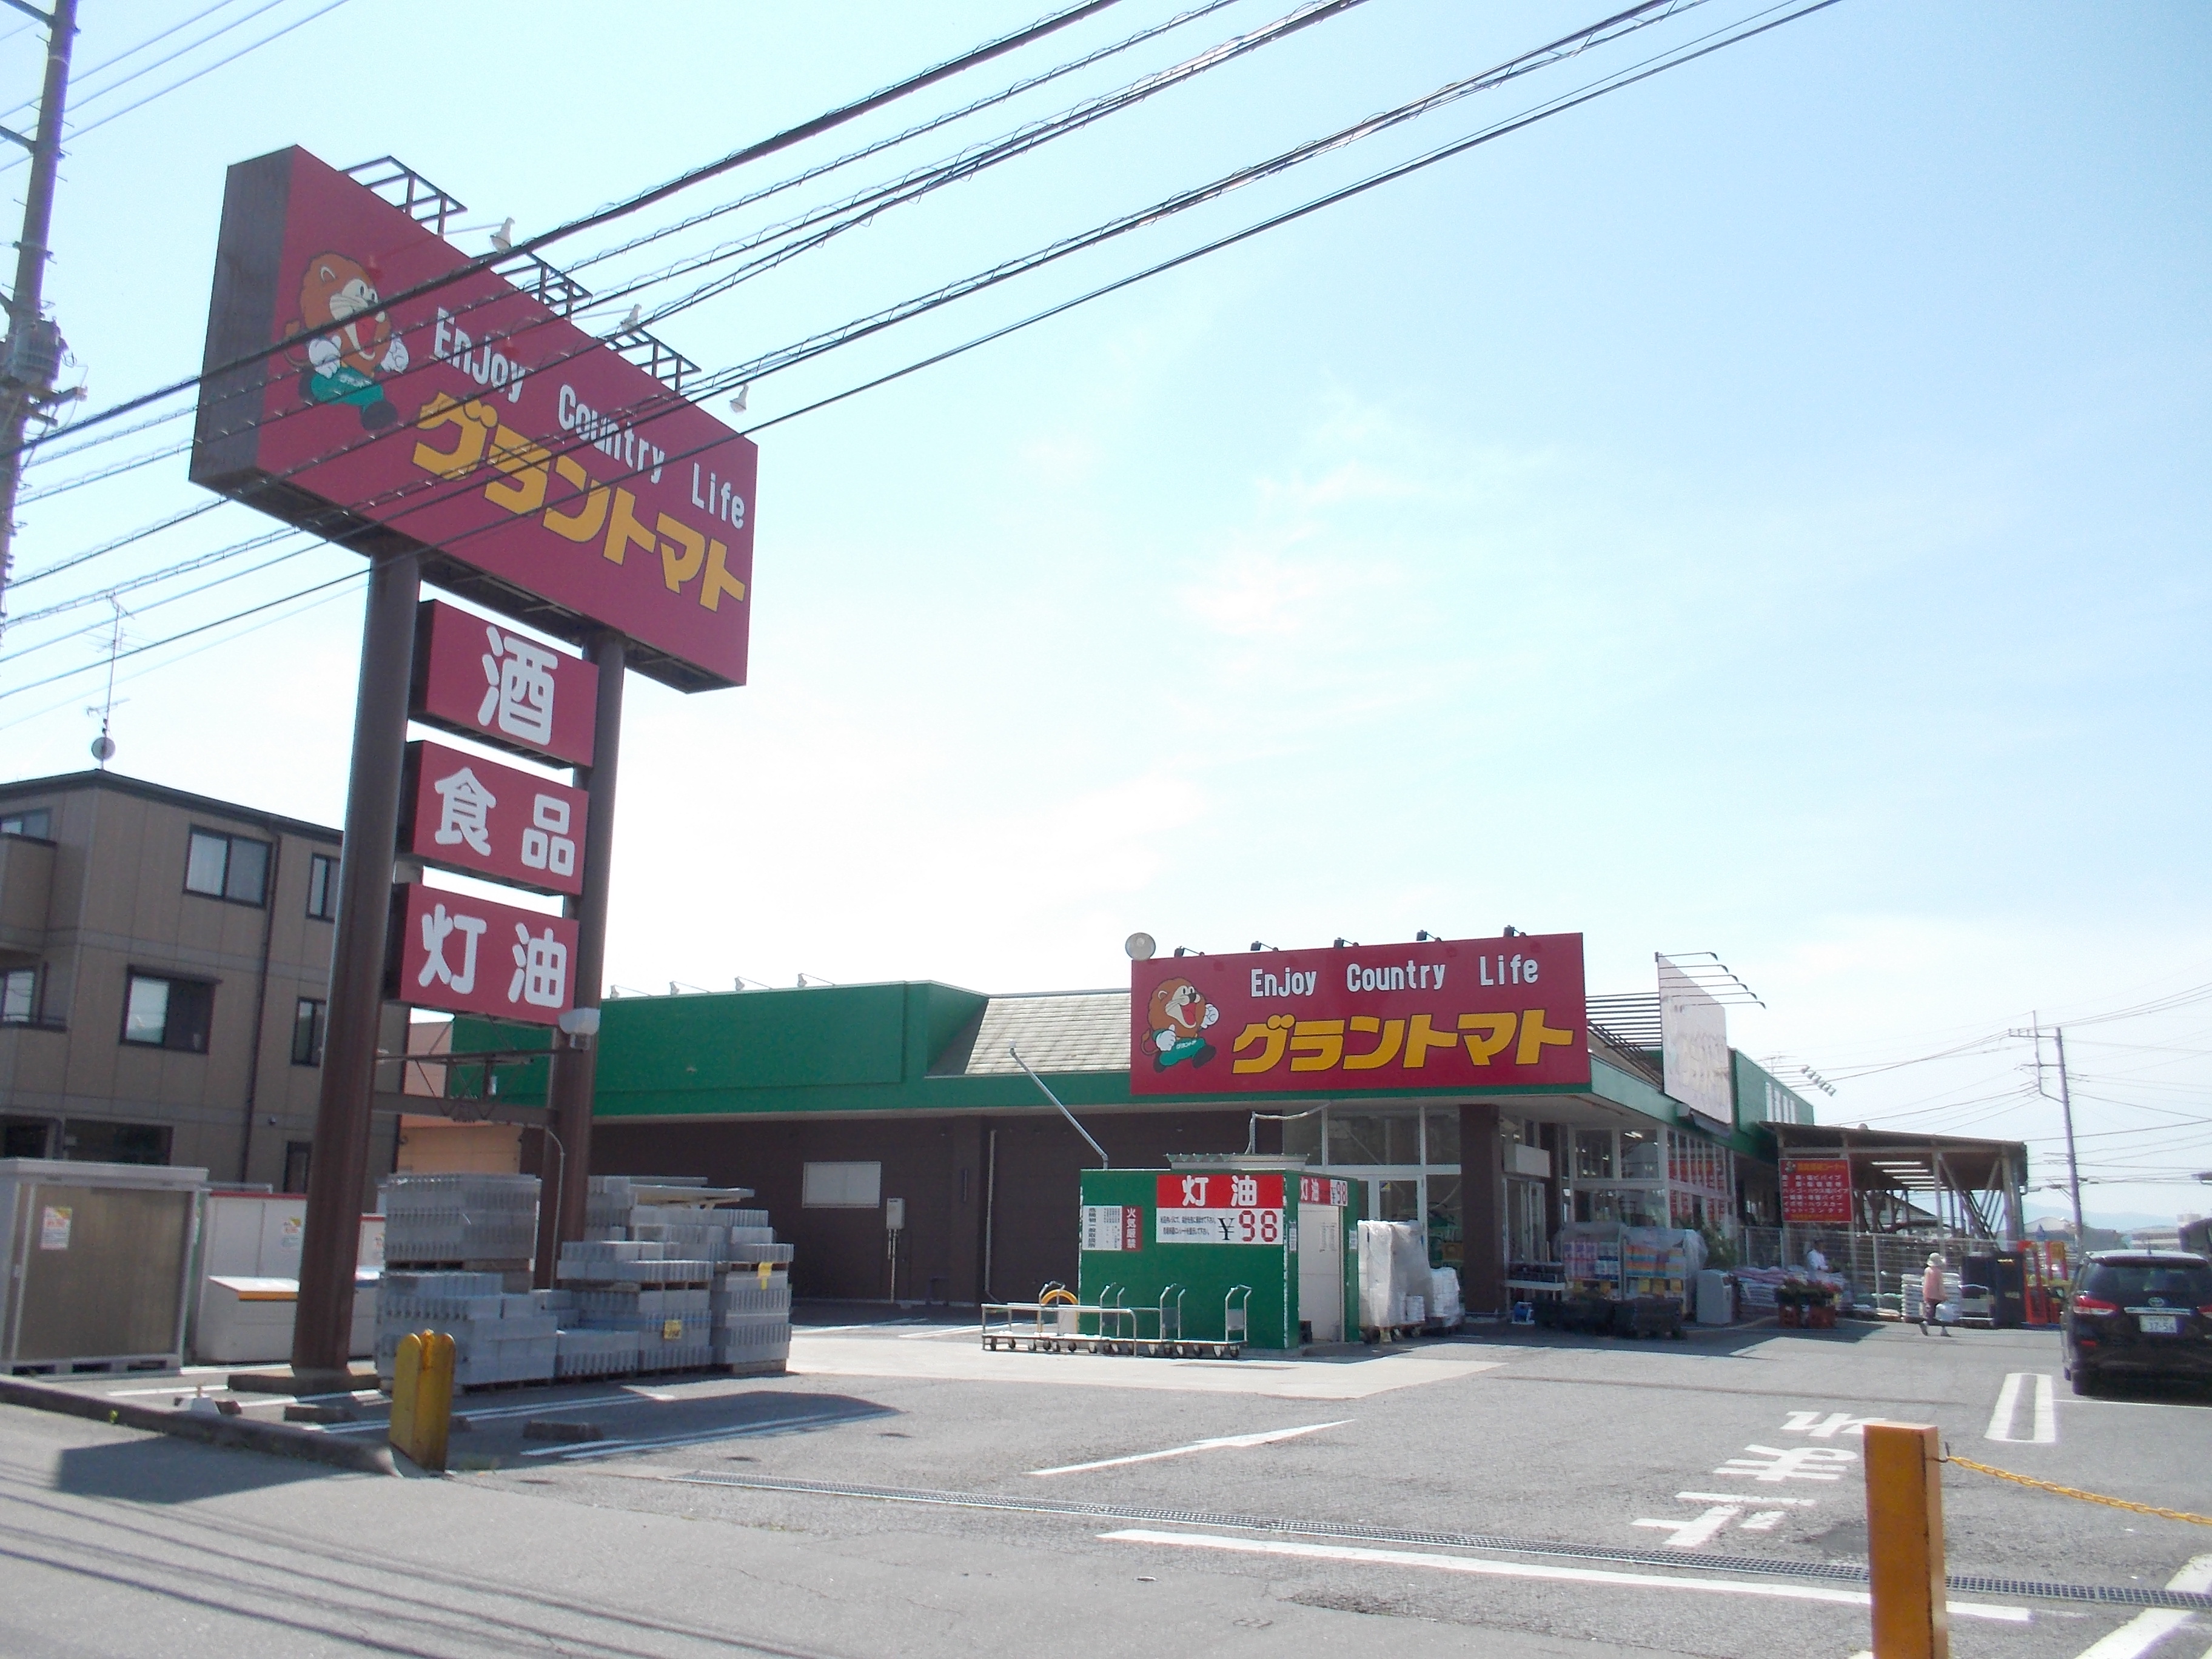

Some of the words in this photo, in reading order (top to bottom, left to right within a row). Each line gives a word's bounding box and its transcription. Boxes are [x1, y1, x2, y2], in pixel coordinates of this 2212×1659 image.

[412, 392, 746, 612] グラントマト
[558, 384, 665, 484] Country
[692, 461, 745, 529] Life
[478, 626, 558, 746] 酒
[1251, 967, 1316, 997] Enjoy
[1347, 960, 1446, 993] Country
[1479, 954, 1539, 986] Life
[1232, 1009, 1574, 1074] グラントマト
